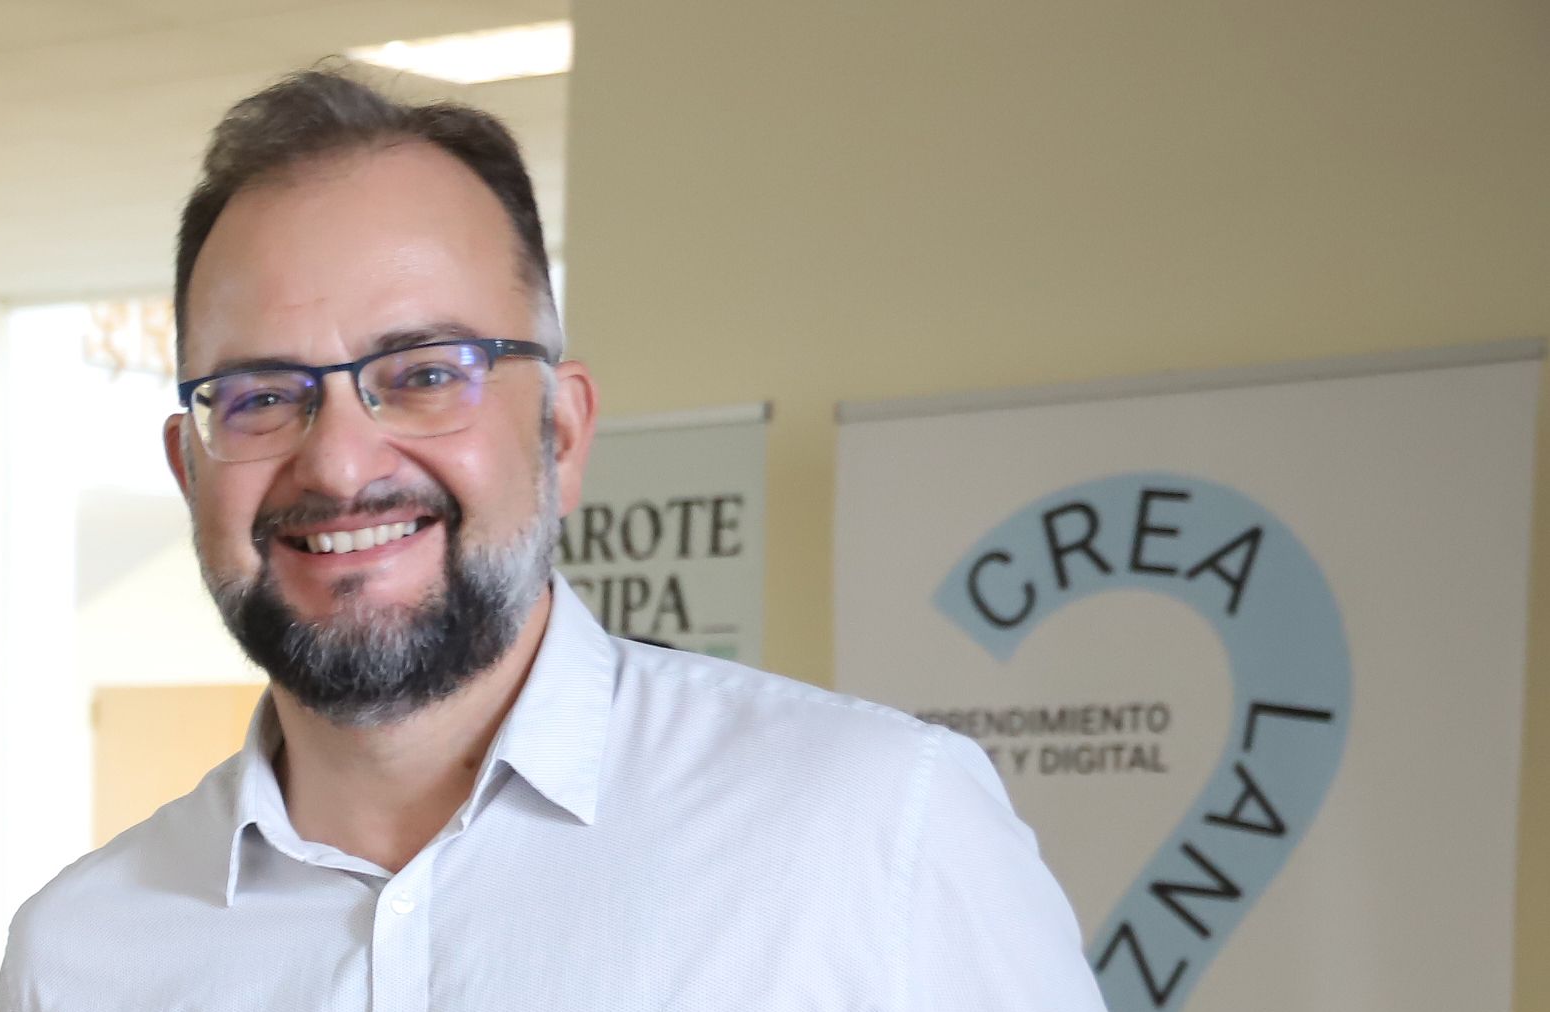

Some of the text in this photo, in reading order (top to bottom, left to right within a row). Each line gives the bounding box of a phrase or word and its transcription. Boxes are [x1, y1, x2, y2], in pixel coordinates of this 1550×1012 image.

[966, 487, 1265, 630] CREA
[1009, 747, 1031, 776] Y
[1038, 743, 1168, 776] DIGITAL
